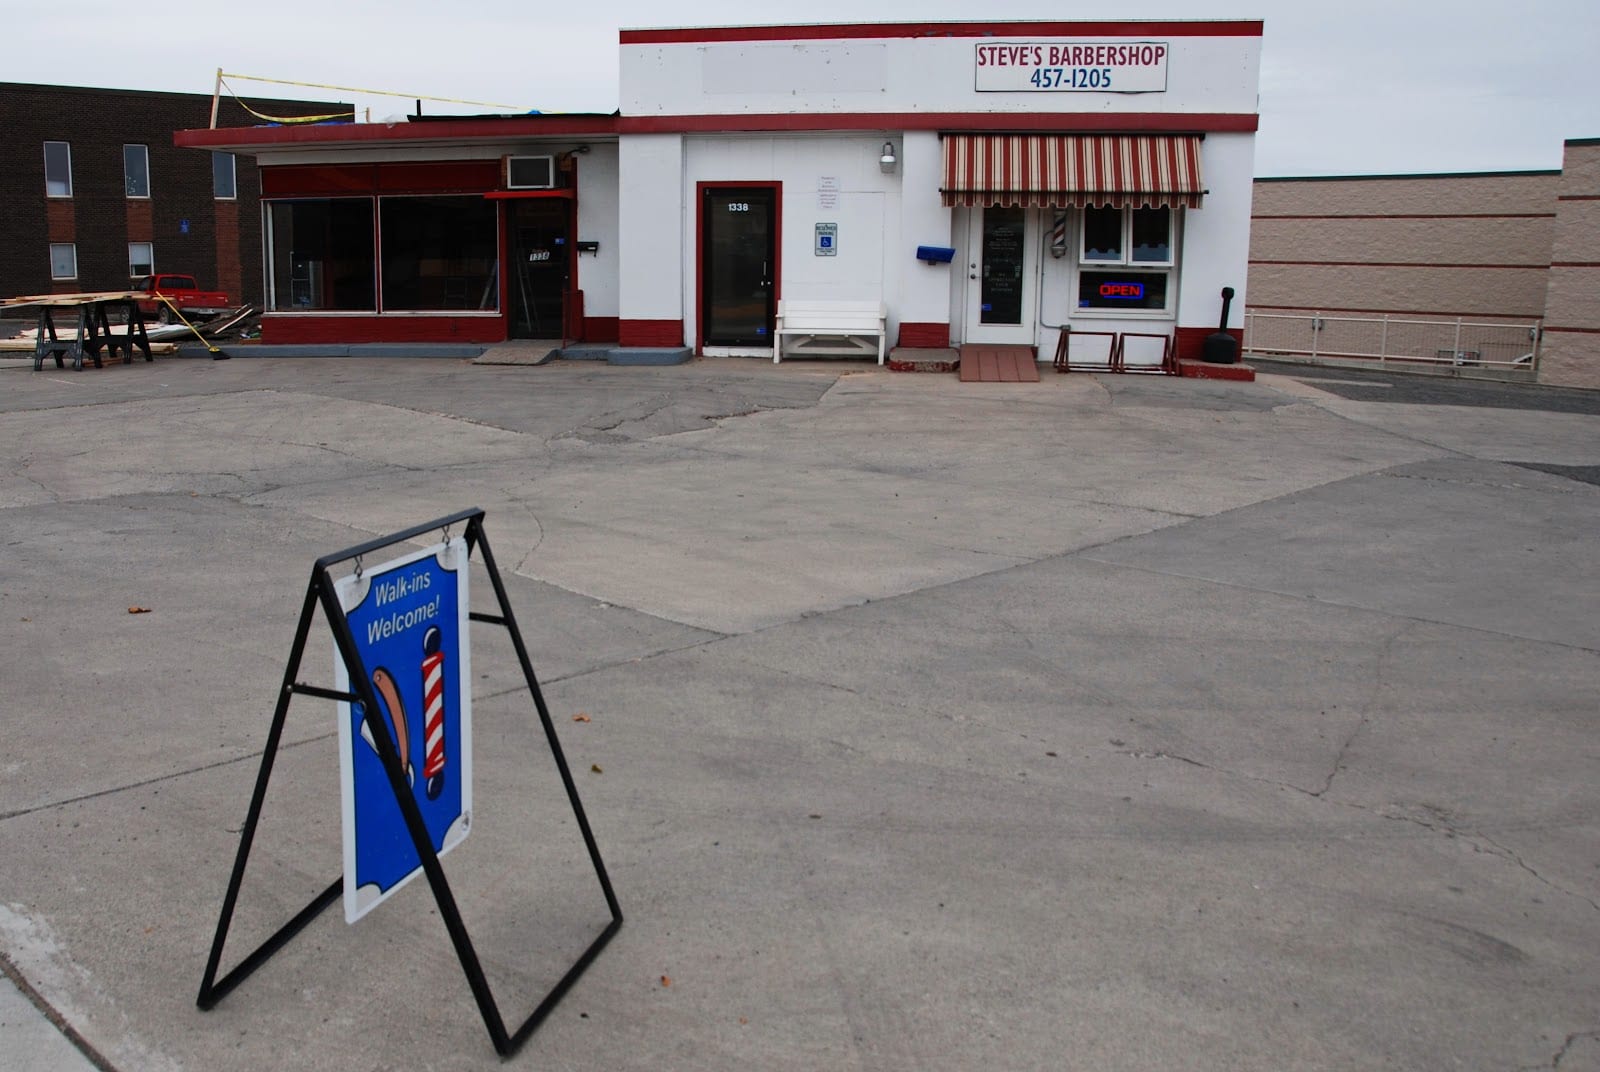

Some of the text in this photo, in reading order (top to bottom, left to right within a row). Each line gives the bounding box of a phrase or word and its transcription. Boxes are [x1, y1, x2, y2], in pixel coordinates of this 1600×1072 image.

[978, 46, 1165, 66] STEVE'S BARBERSHOP
[1030, 68, 1111, 88] 457-1205
[728, 203, 749, 212] 1338
[1099, 284, 1140, 296] OPEN
[375, 571, 431, 607] Walk-ins
[367, 594, 440, 645] Welcome!
